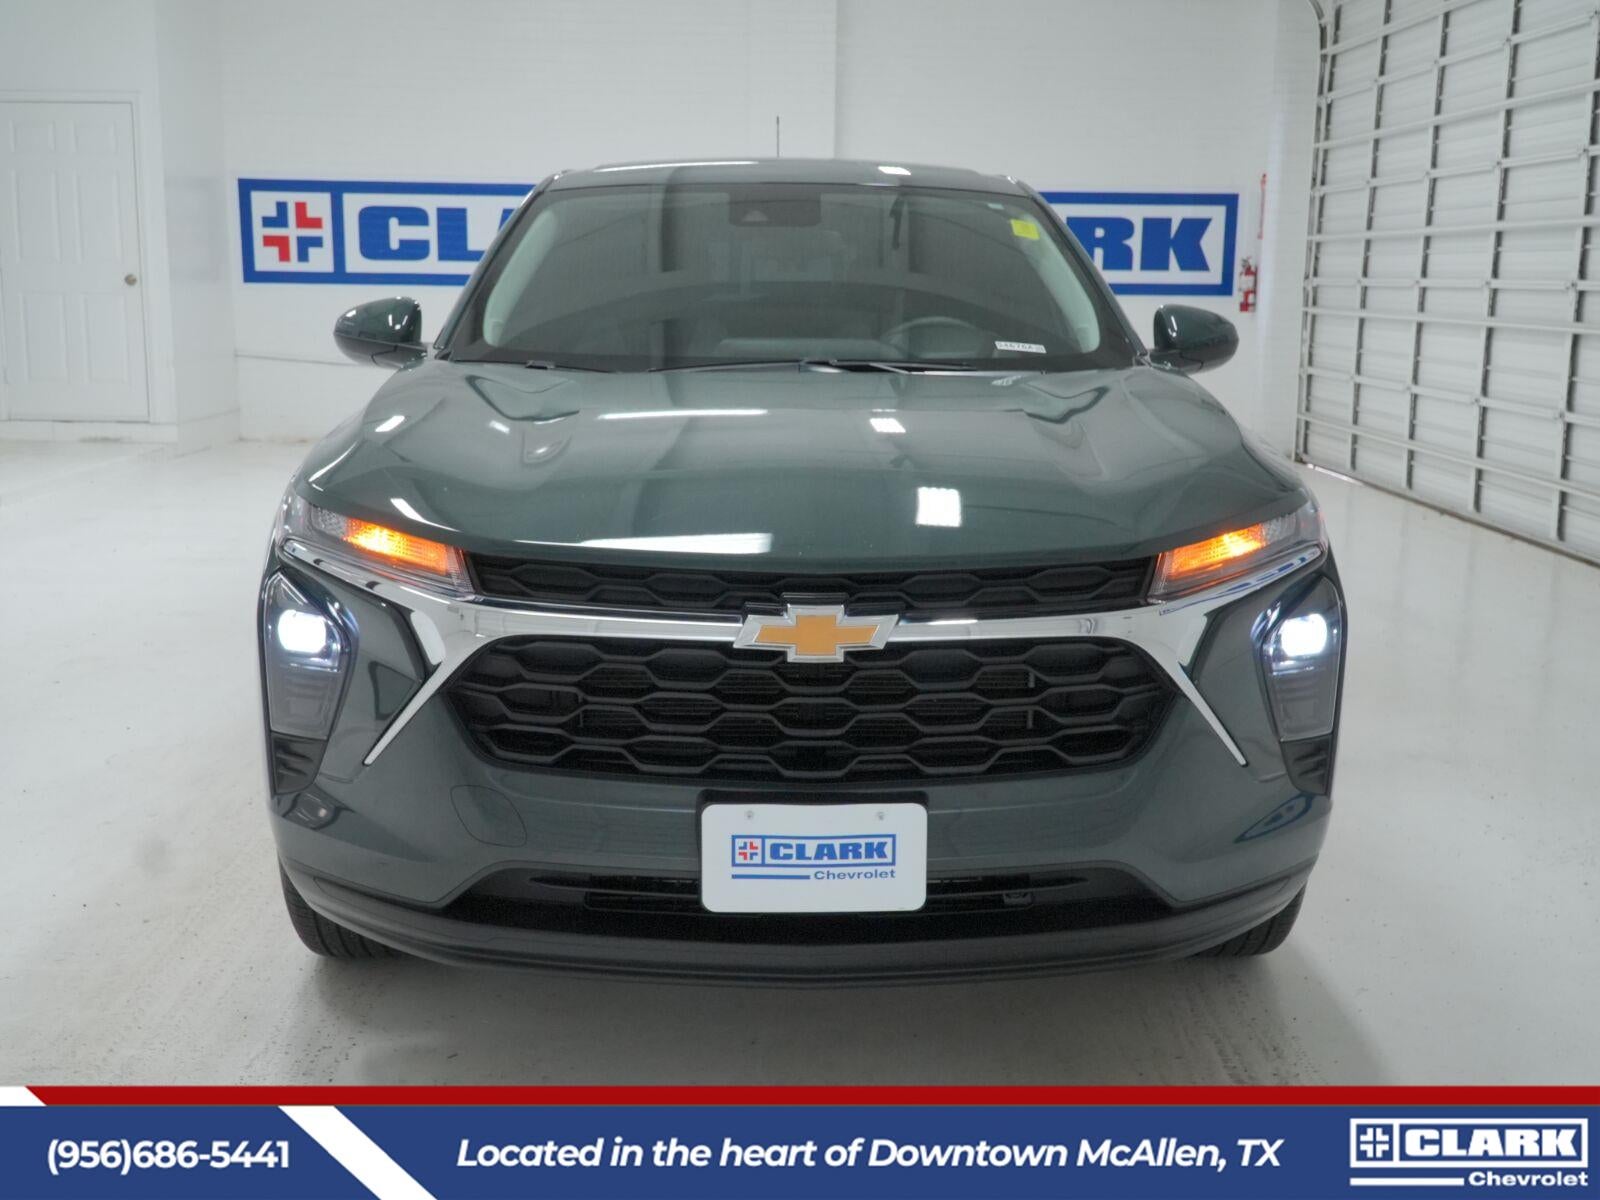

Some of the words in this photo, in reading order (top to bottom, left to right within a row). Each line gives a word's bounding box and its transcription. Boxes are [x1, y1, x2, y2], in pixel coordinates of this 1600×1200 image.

[358, 205, 516, 262] CL
[769, 841, 888, 861] CLARK
[813, 869, 896, 881] Chevrolet
